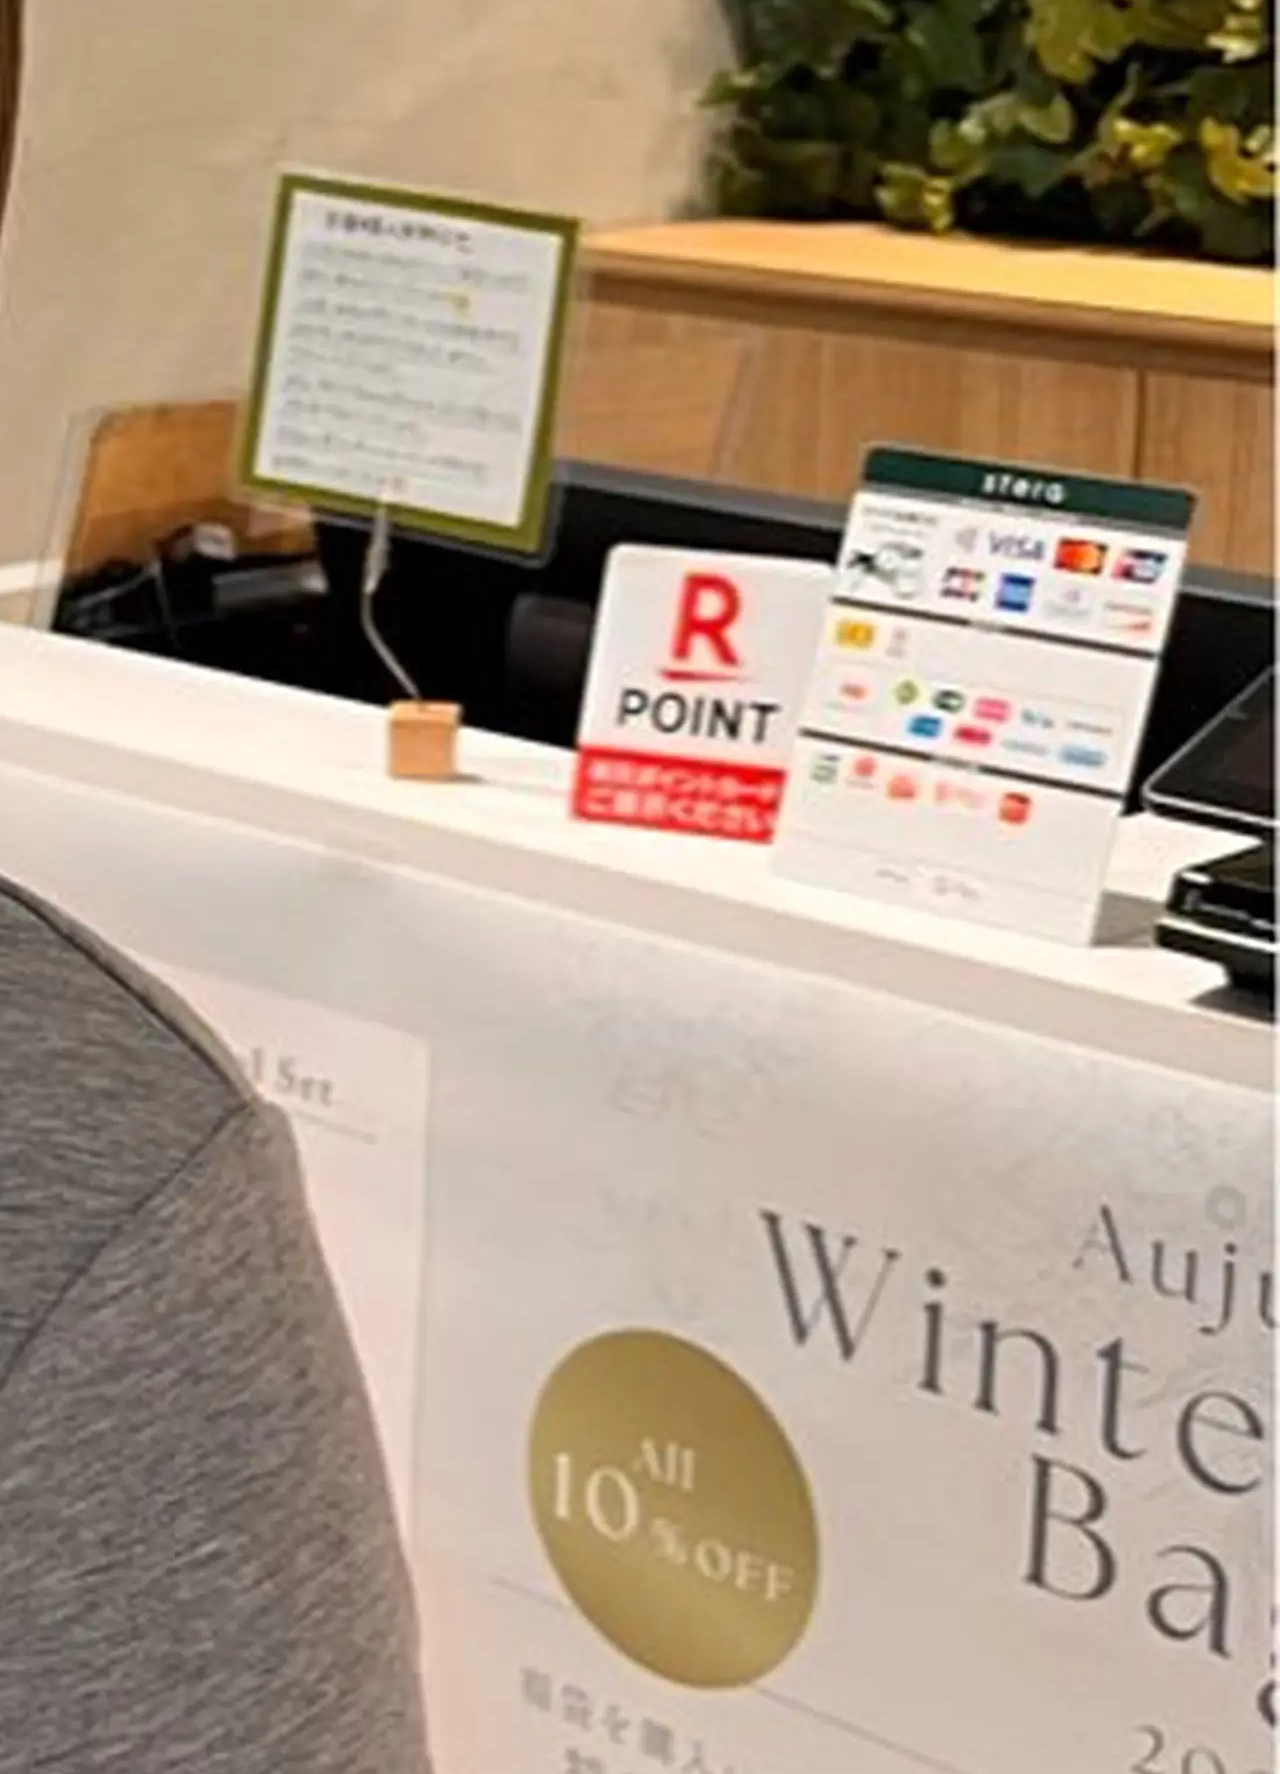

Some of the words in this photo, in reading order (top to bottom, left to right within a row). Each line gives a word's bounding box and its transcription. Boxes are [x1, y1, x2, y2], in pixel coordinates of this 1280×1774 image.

[987, 528, 1045, 561] VISA
[673, 572, 742, 666] R
[616, 687, 781, 743] POINT
[632, 1437, 695, 1492] All
[1023, 1453, 1276, 1727] Ba
